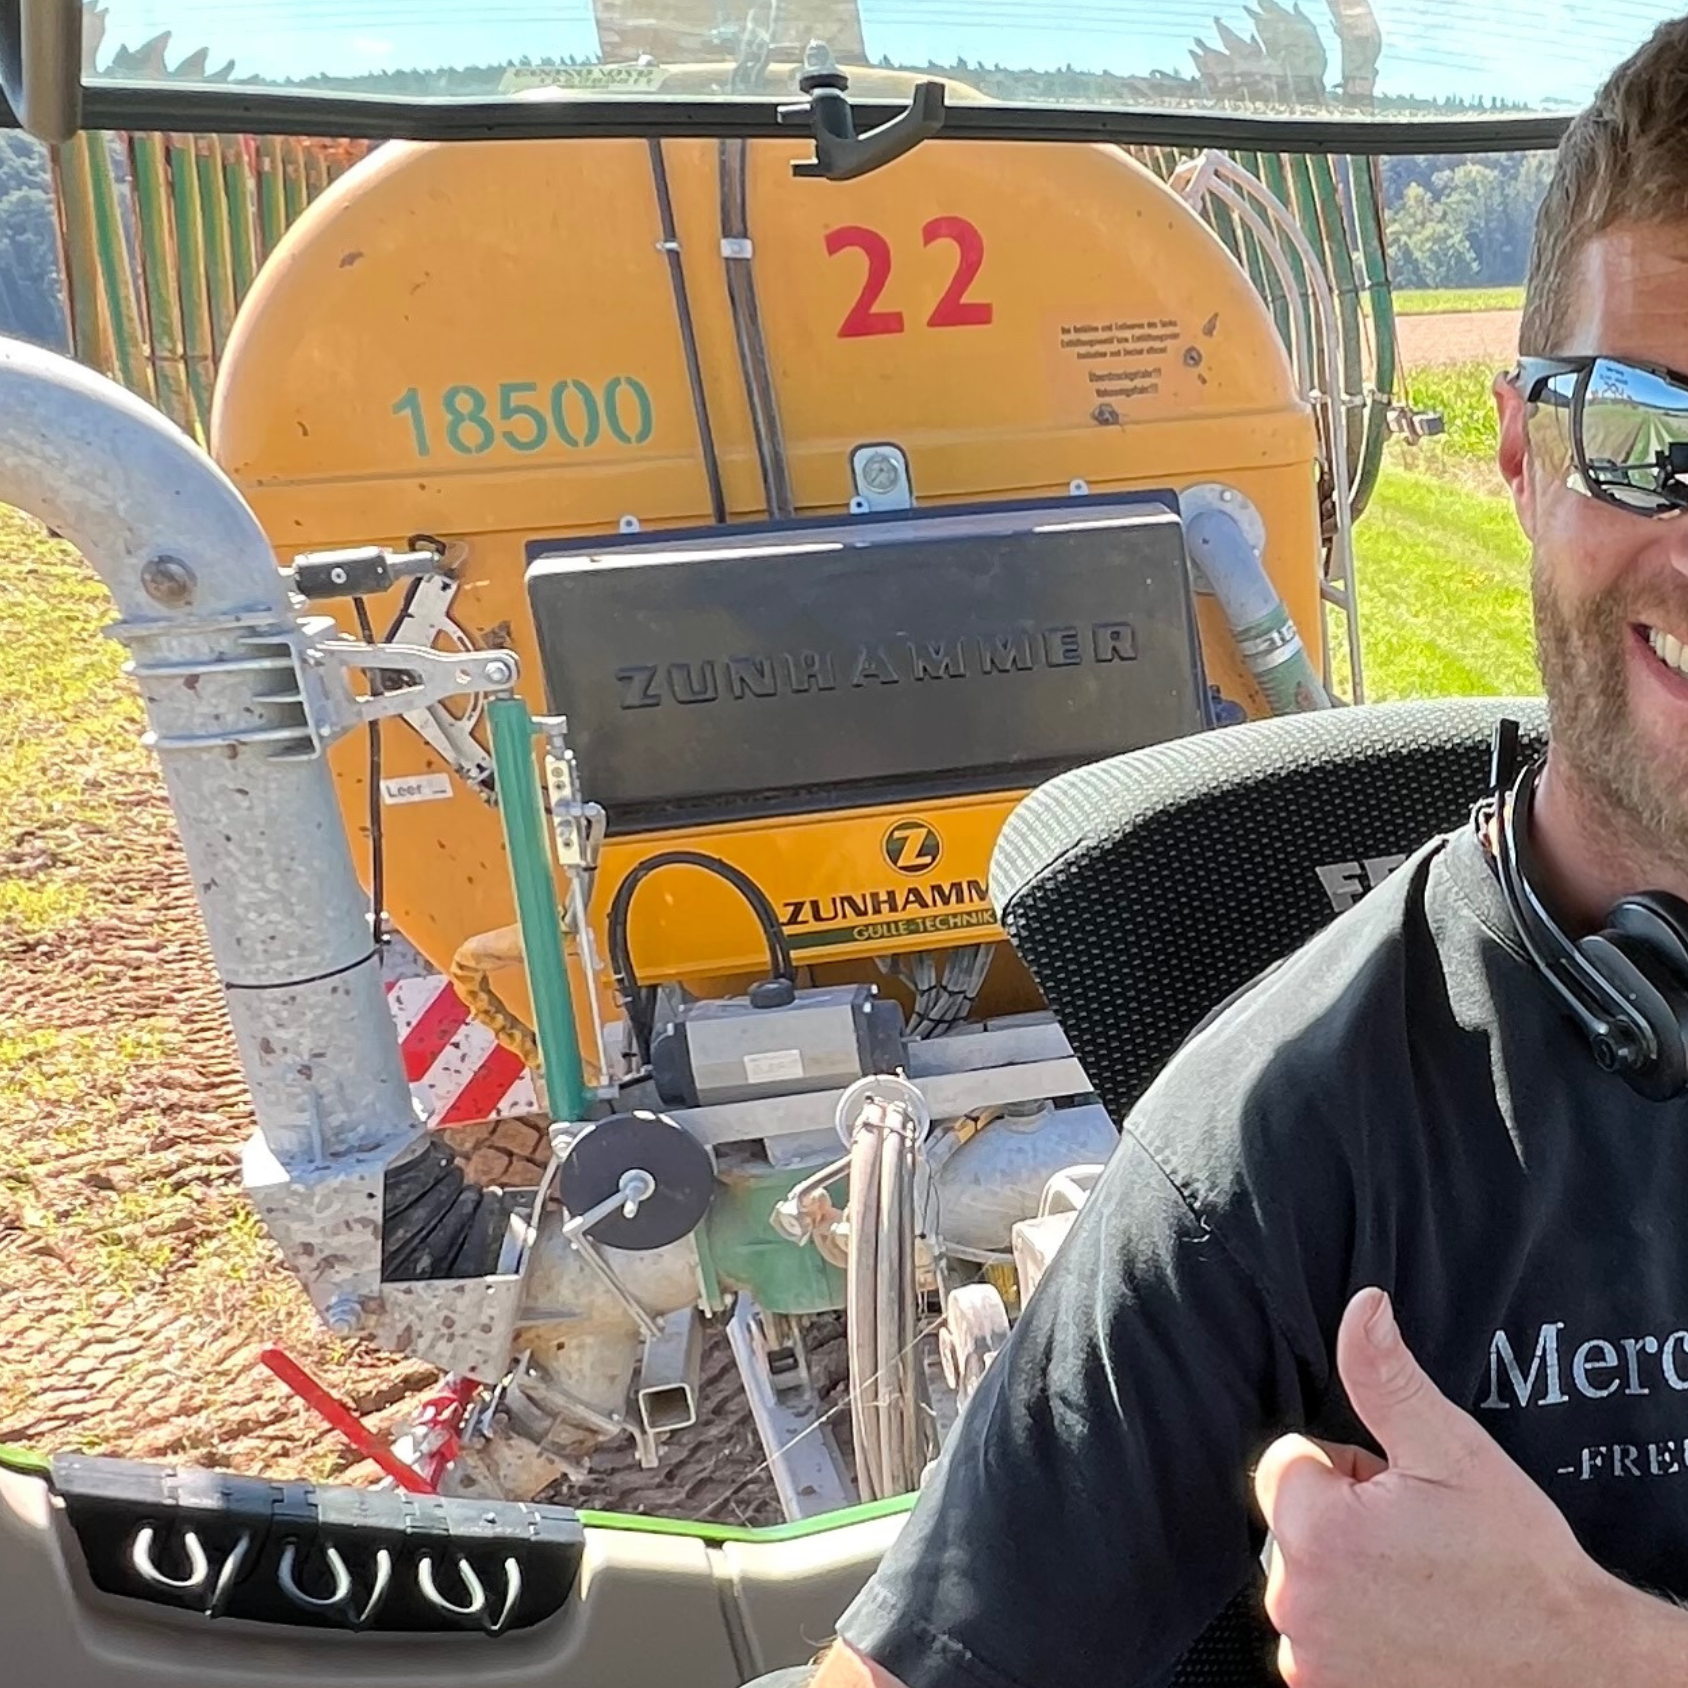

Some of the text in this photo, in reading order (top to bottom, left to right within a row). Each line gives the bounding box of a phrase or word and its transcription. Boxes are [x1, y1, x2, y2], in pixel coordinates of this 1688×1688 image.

[824, 216, 993, 339] 22
[393, 376, 652, 457] 18500
[615, 622, 1139, 710] ZUNHAMMER
[780, 879, 988, 926] ZUNHAMM
